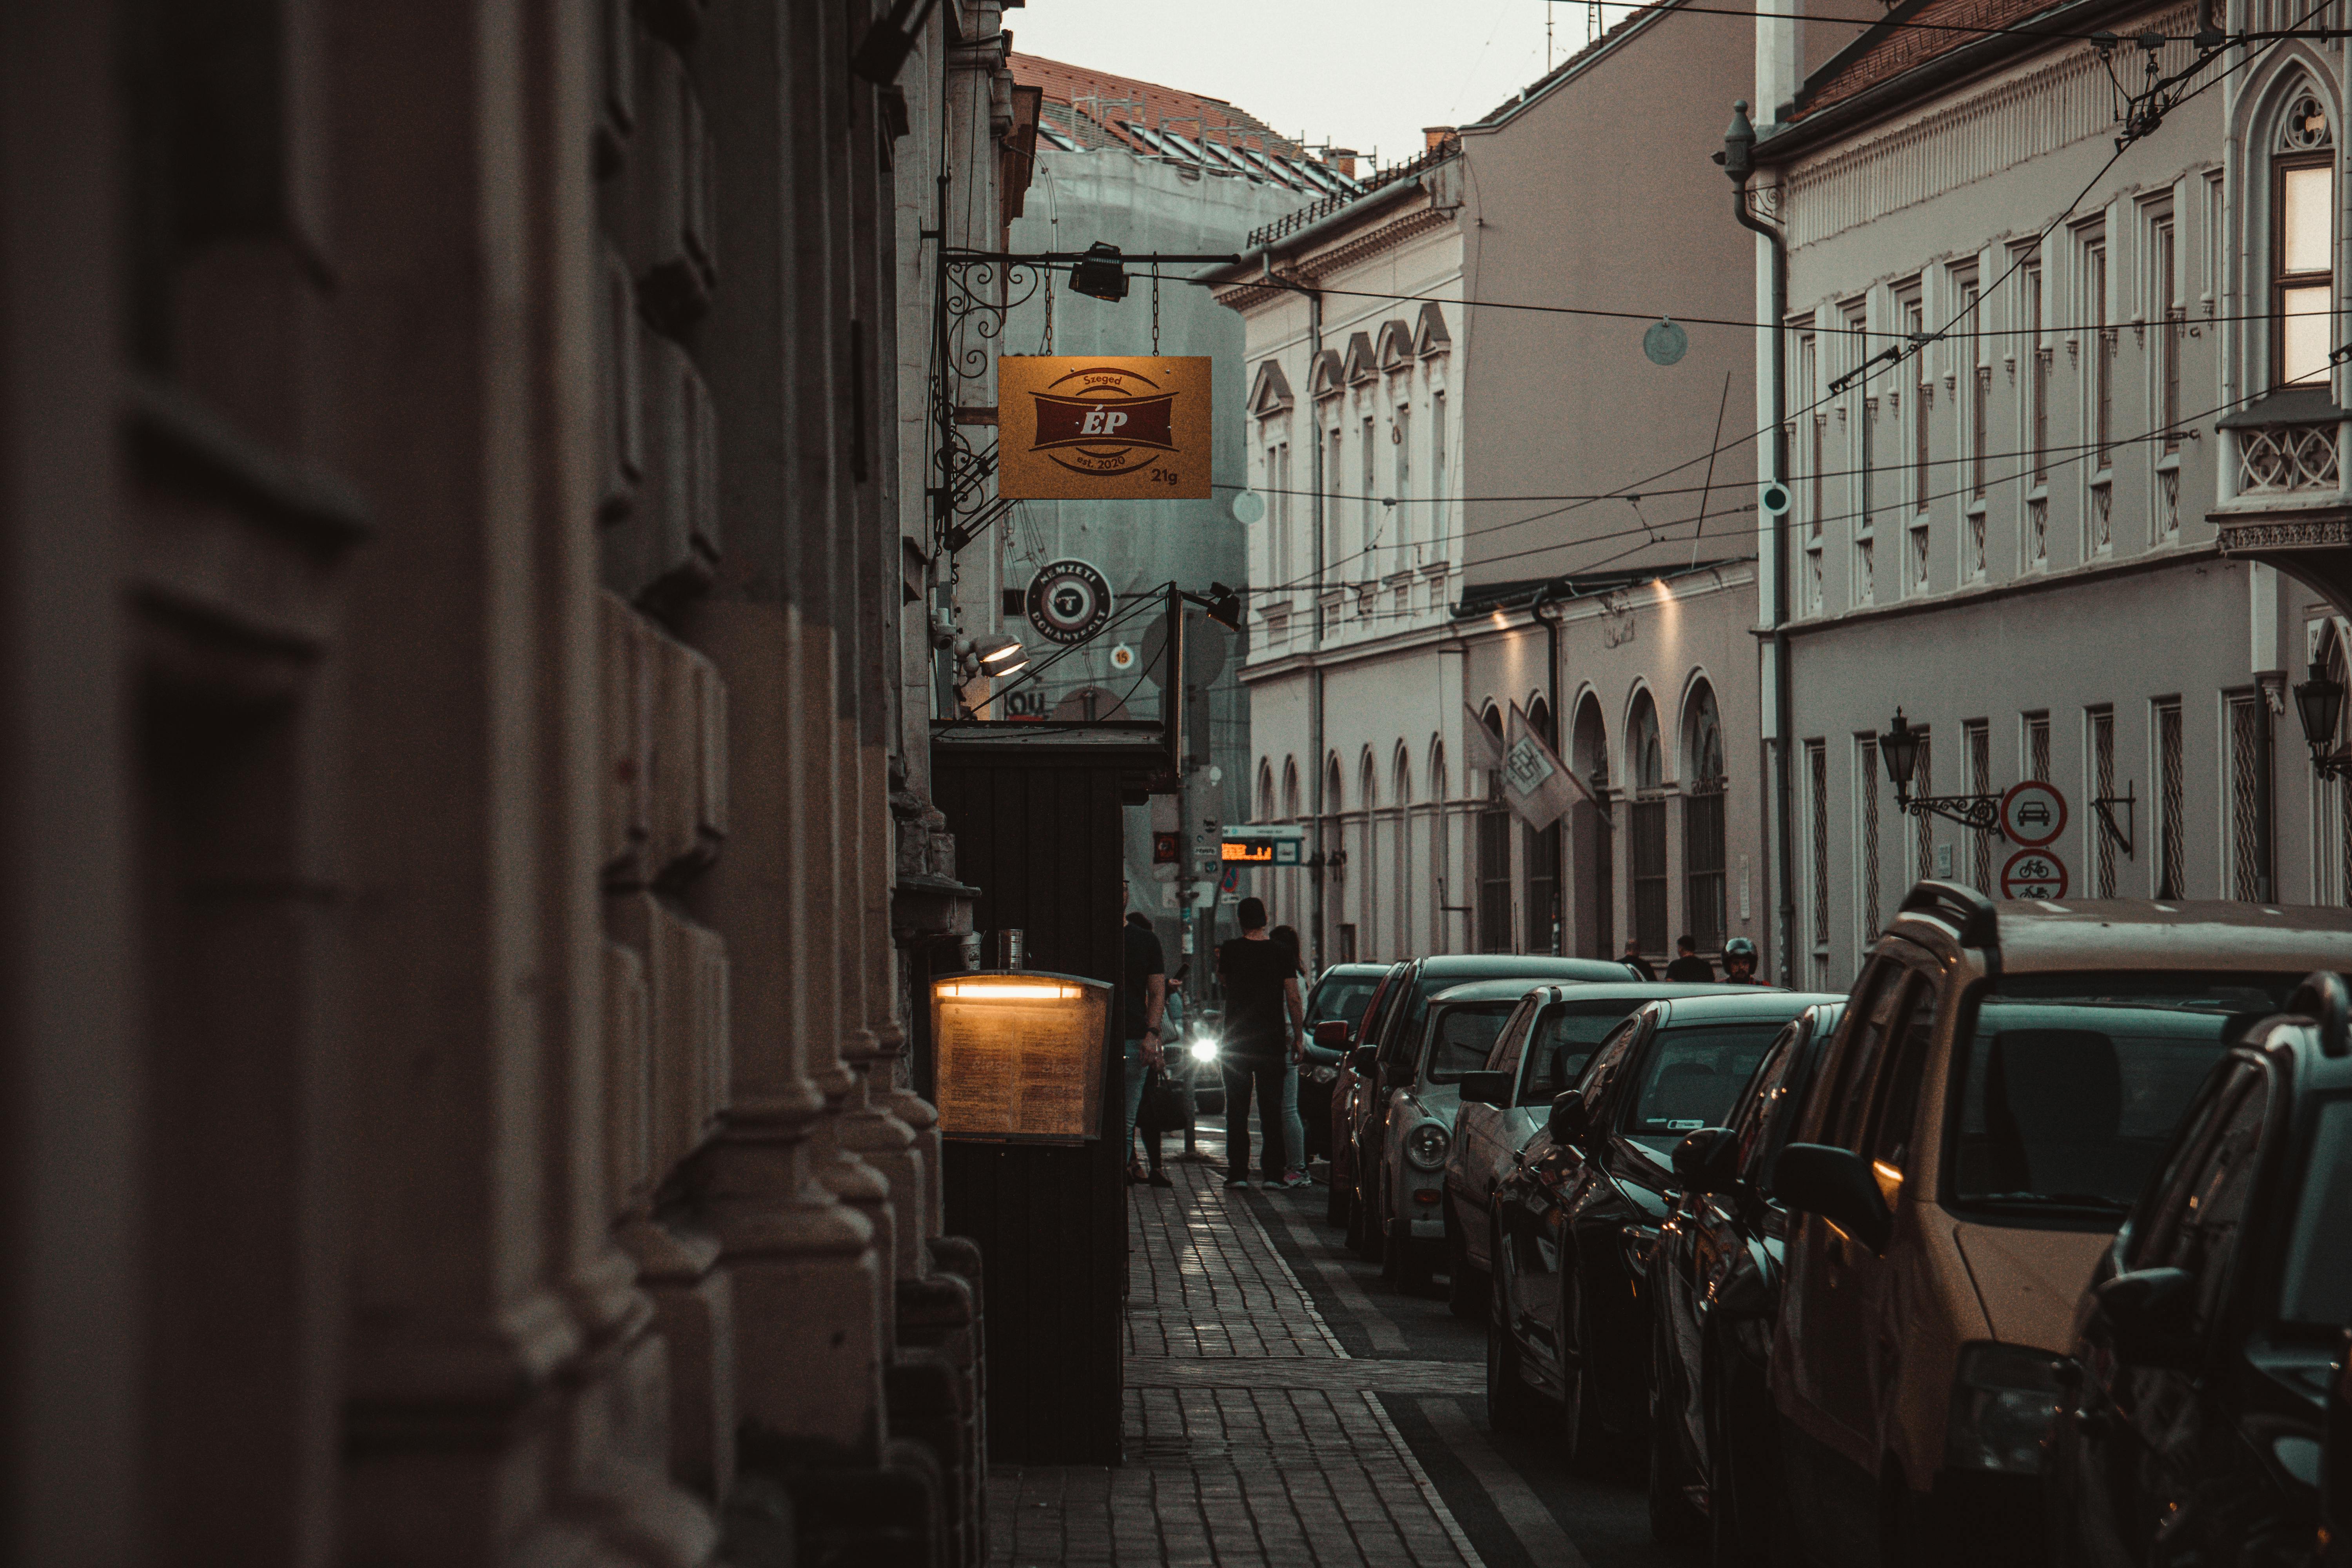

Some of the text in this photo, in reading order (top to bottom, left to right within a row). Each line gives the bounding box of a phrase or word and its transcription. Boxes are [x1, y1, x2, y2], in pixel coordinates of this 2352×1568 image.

[1083, 376, 1122, 385] Szeged
[1080, 404, 1128, 434] ÉP
[1077, 456, 1125, 469] est. 2020
[1151, 468, 1178, 486] 21g
[1040, 564, 1097, 584] NEMZETI
